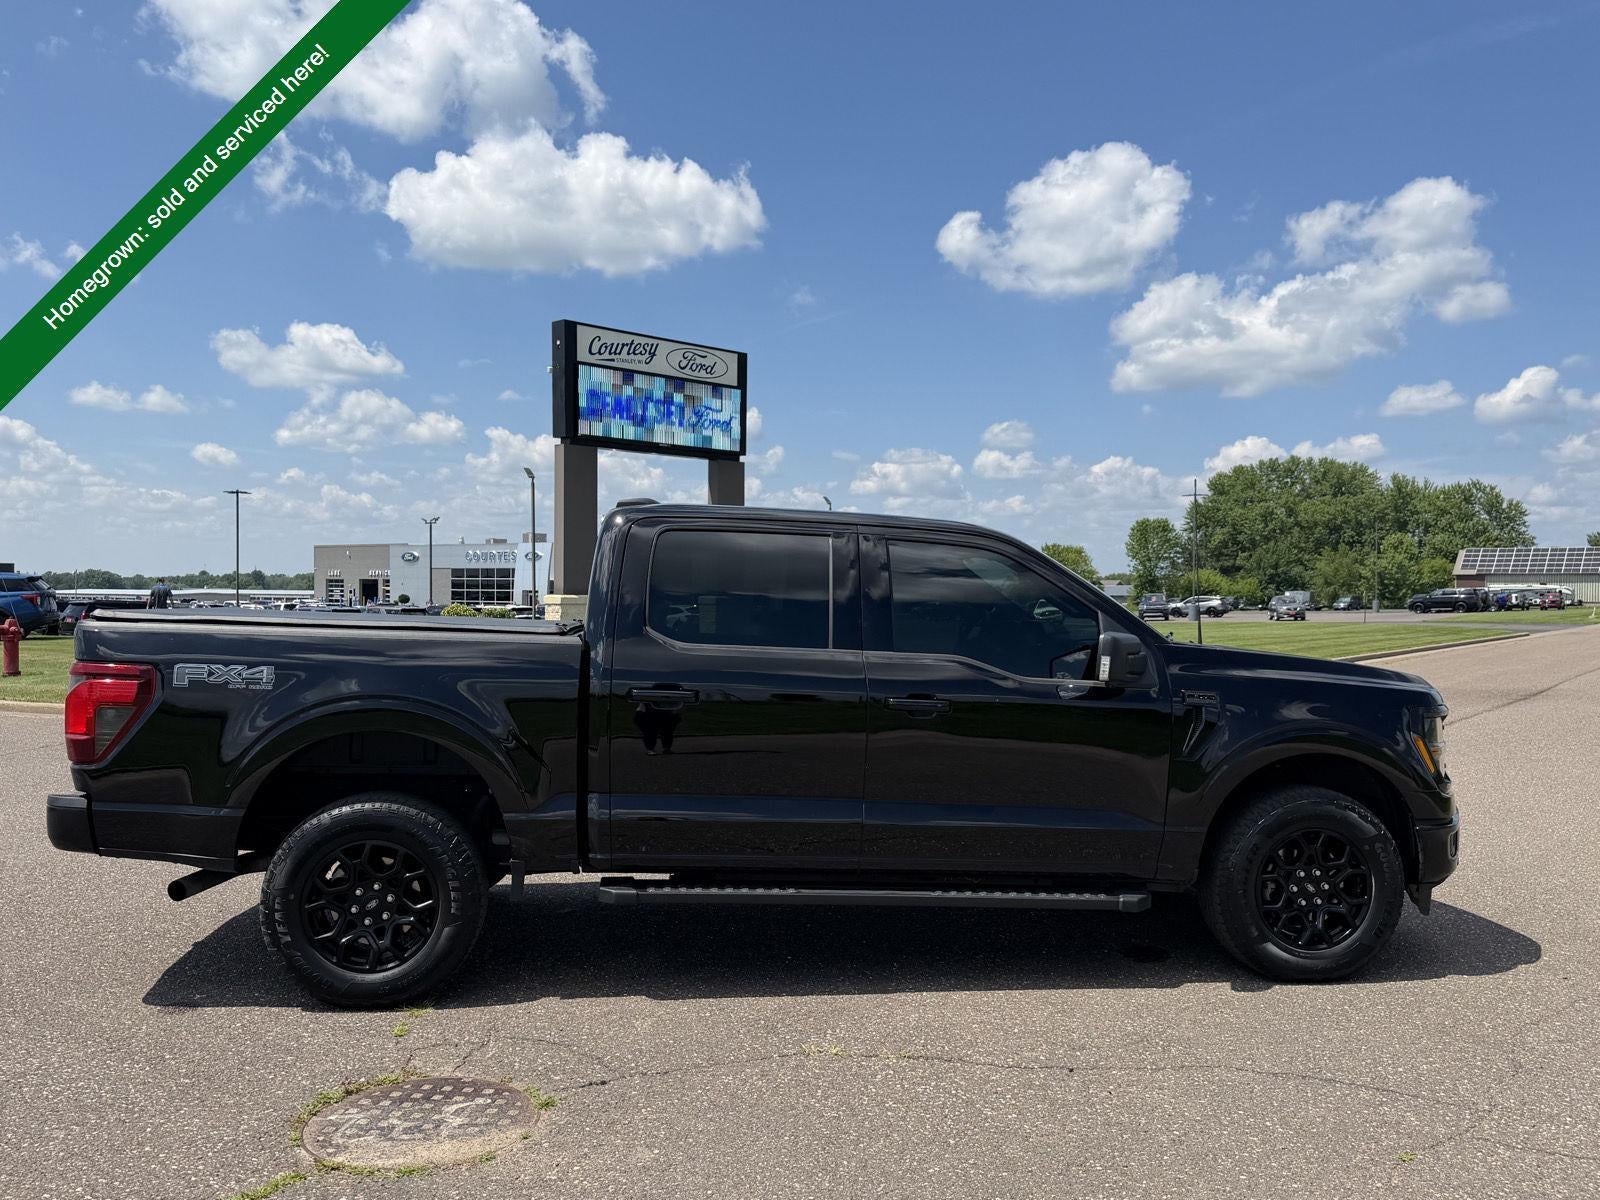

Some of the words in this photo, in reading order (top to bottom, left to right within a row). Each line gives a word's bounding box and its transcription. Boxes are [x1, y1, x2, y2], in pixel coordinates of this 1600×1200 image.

[588, 335, 660, 365] Courtesy
[678, 350, 717, 376] Ford
[687, 403, 736, 433] Ford
[173, 663, 275, 688] FX4
